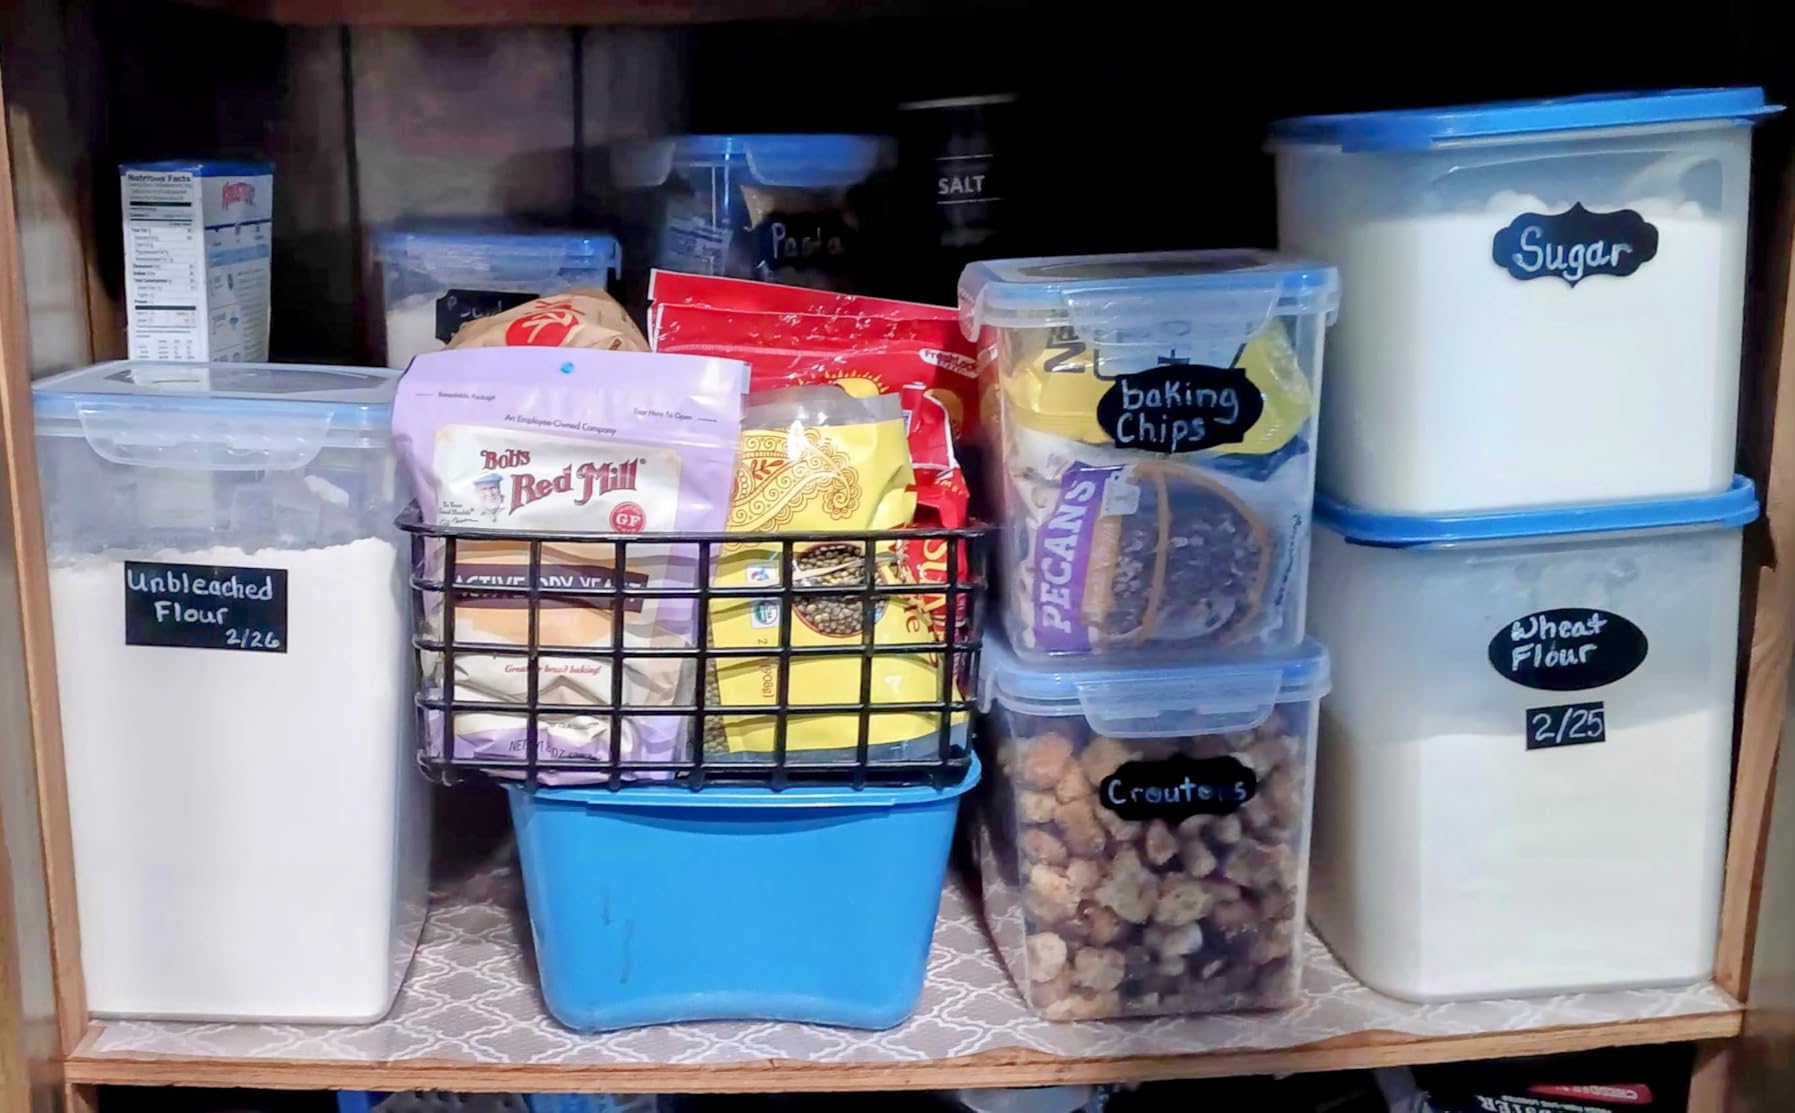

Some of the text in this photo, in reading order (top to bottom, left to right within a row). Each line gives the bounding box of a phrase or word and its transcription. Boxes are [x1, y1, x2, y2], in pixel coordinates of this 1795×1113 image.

[168, 174, 191, 183] Facts
[938, 175, 985, 195] SALT
[1512, 225, 1632, 281] Sugar
[1122, 379, 1239, 424] baking
[504, 413, 617, 436] An Employee-Owned Company
[1116, 414, 1206, 453] Chips
[509, 457, 638, 516] Red Mill
[615, 513, 641, 527] GF
[1040, 479, 1096, 635] PECANS
[127, 569, 273, 601] Unbleached
[154, 601, 229, 624] Flour
[226, 628, 280, 648] 2/26
[1511, 613, 1607, 641] Wheat
[505, 664, 532, 673] Grea
[1511, 642, 1598, 671] Flour
[1532, 707, 1605, 744] 2/25
